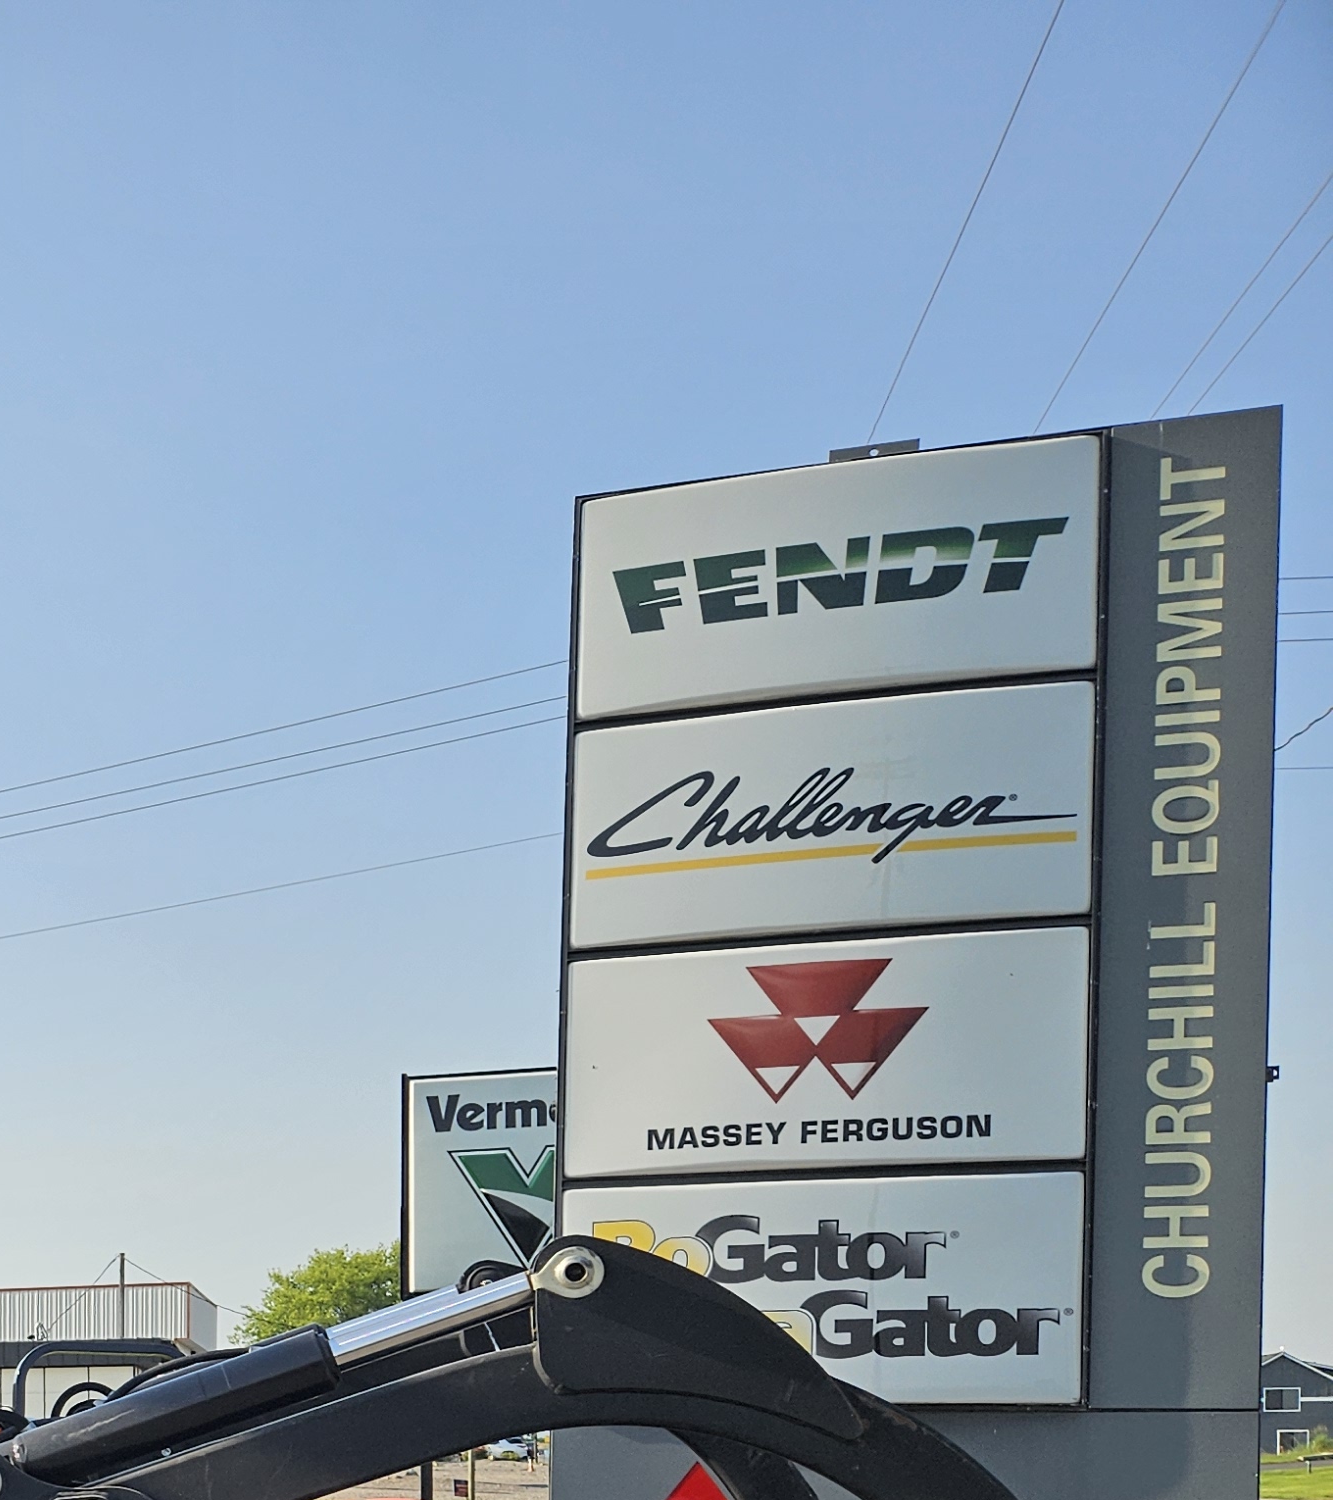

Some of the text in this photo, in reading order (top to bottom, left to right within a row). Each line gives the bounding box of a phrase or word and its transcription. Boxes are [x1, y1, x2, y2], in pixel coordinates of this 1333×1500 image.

[613, 517, 1069, 634] FENDT
[1141, 457, 1227, 1298] CHURCHILL EQUIPMENT
[425, 1094, 556, 1132] Verm
[647, 1114, 992, 1150] MASSEY FERGUSON
